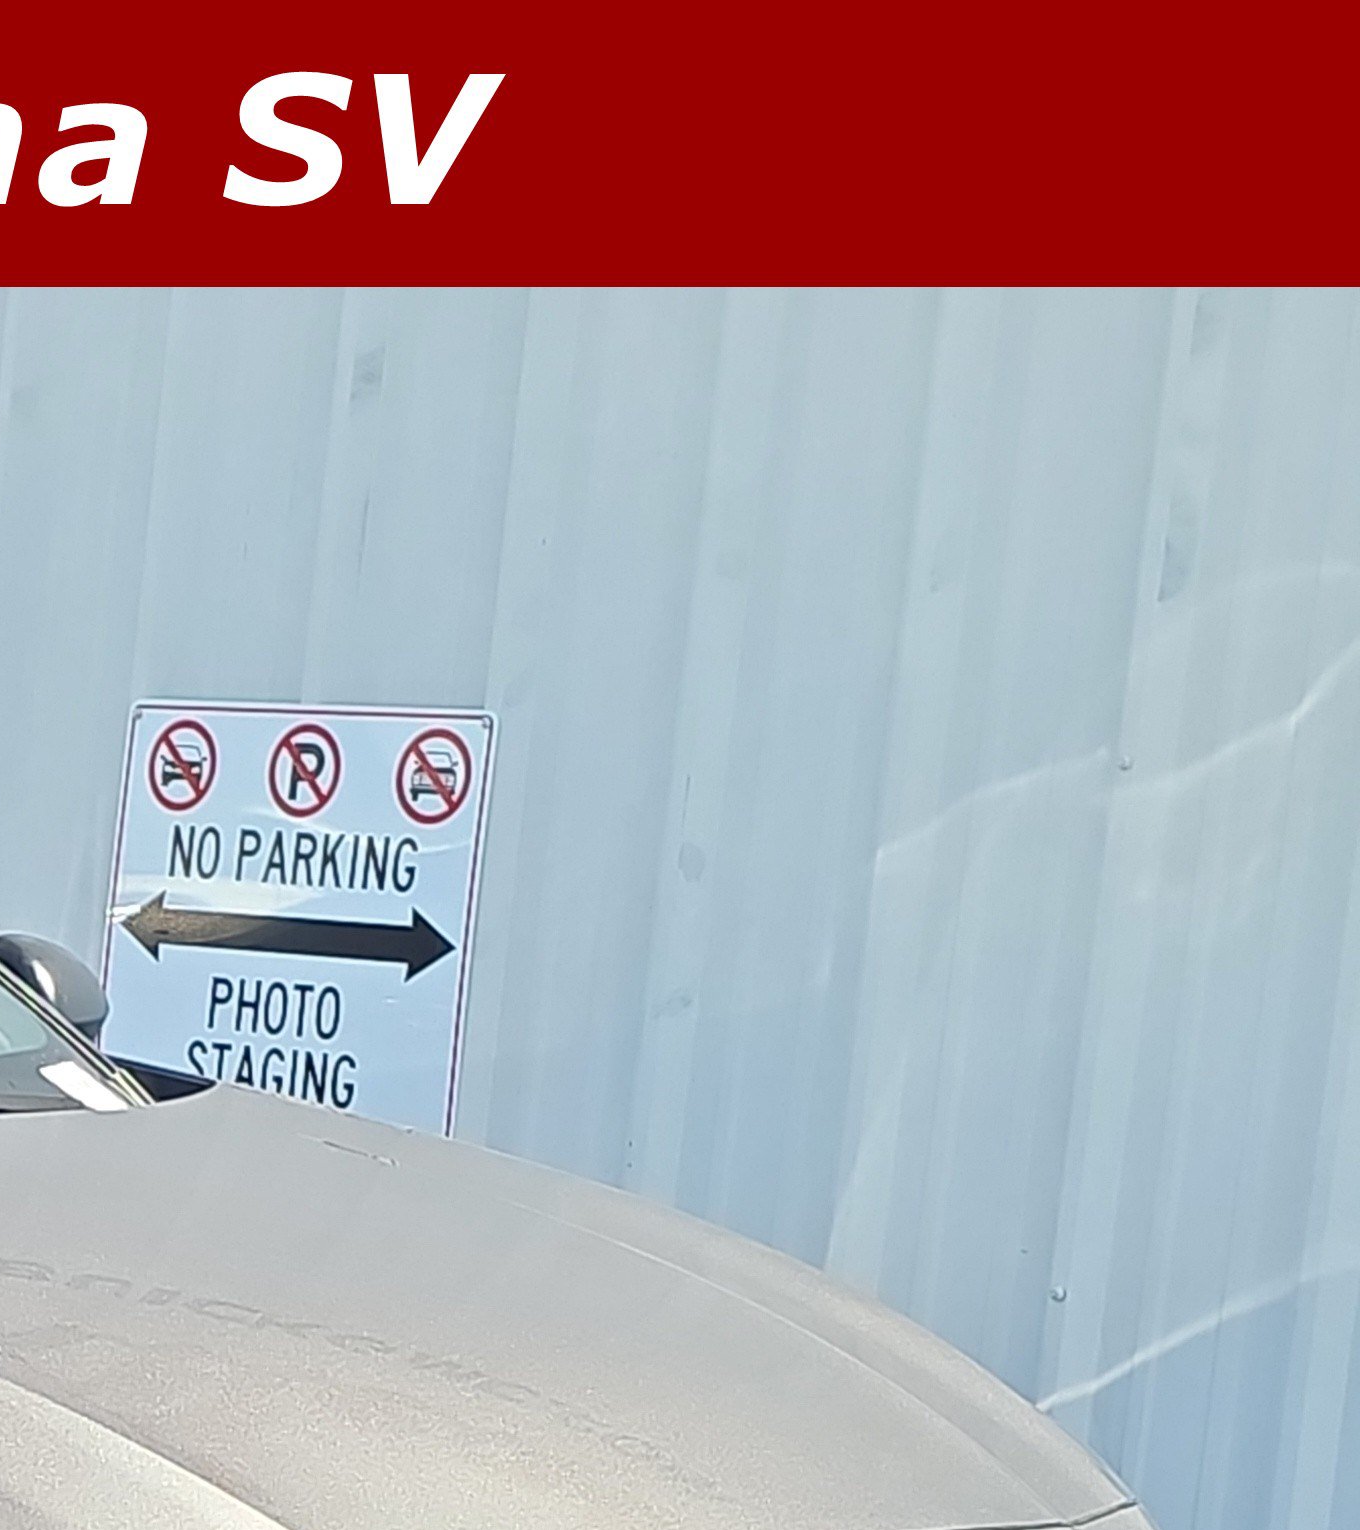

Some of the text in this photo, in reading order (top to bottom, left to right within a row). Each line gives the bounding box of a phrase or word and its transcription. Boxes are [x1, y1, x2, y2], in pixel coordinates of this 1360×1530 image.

[168, 825, 419, 892] NO PARKING
[207, 976, 341, 1040] PHOTO
[187, 1040, 358, 1109] STAGING
